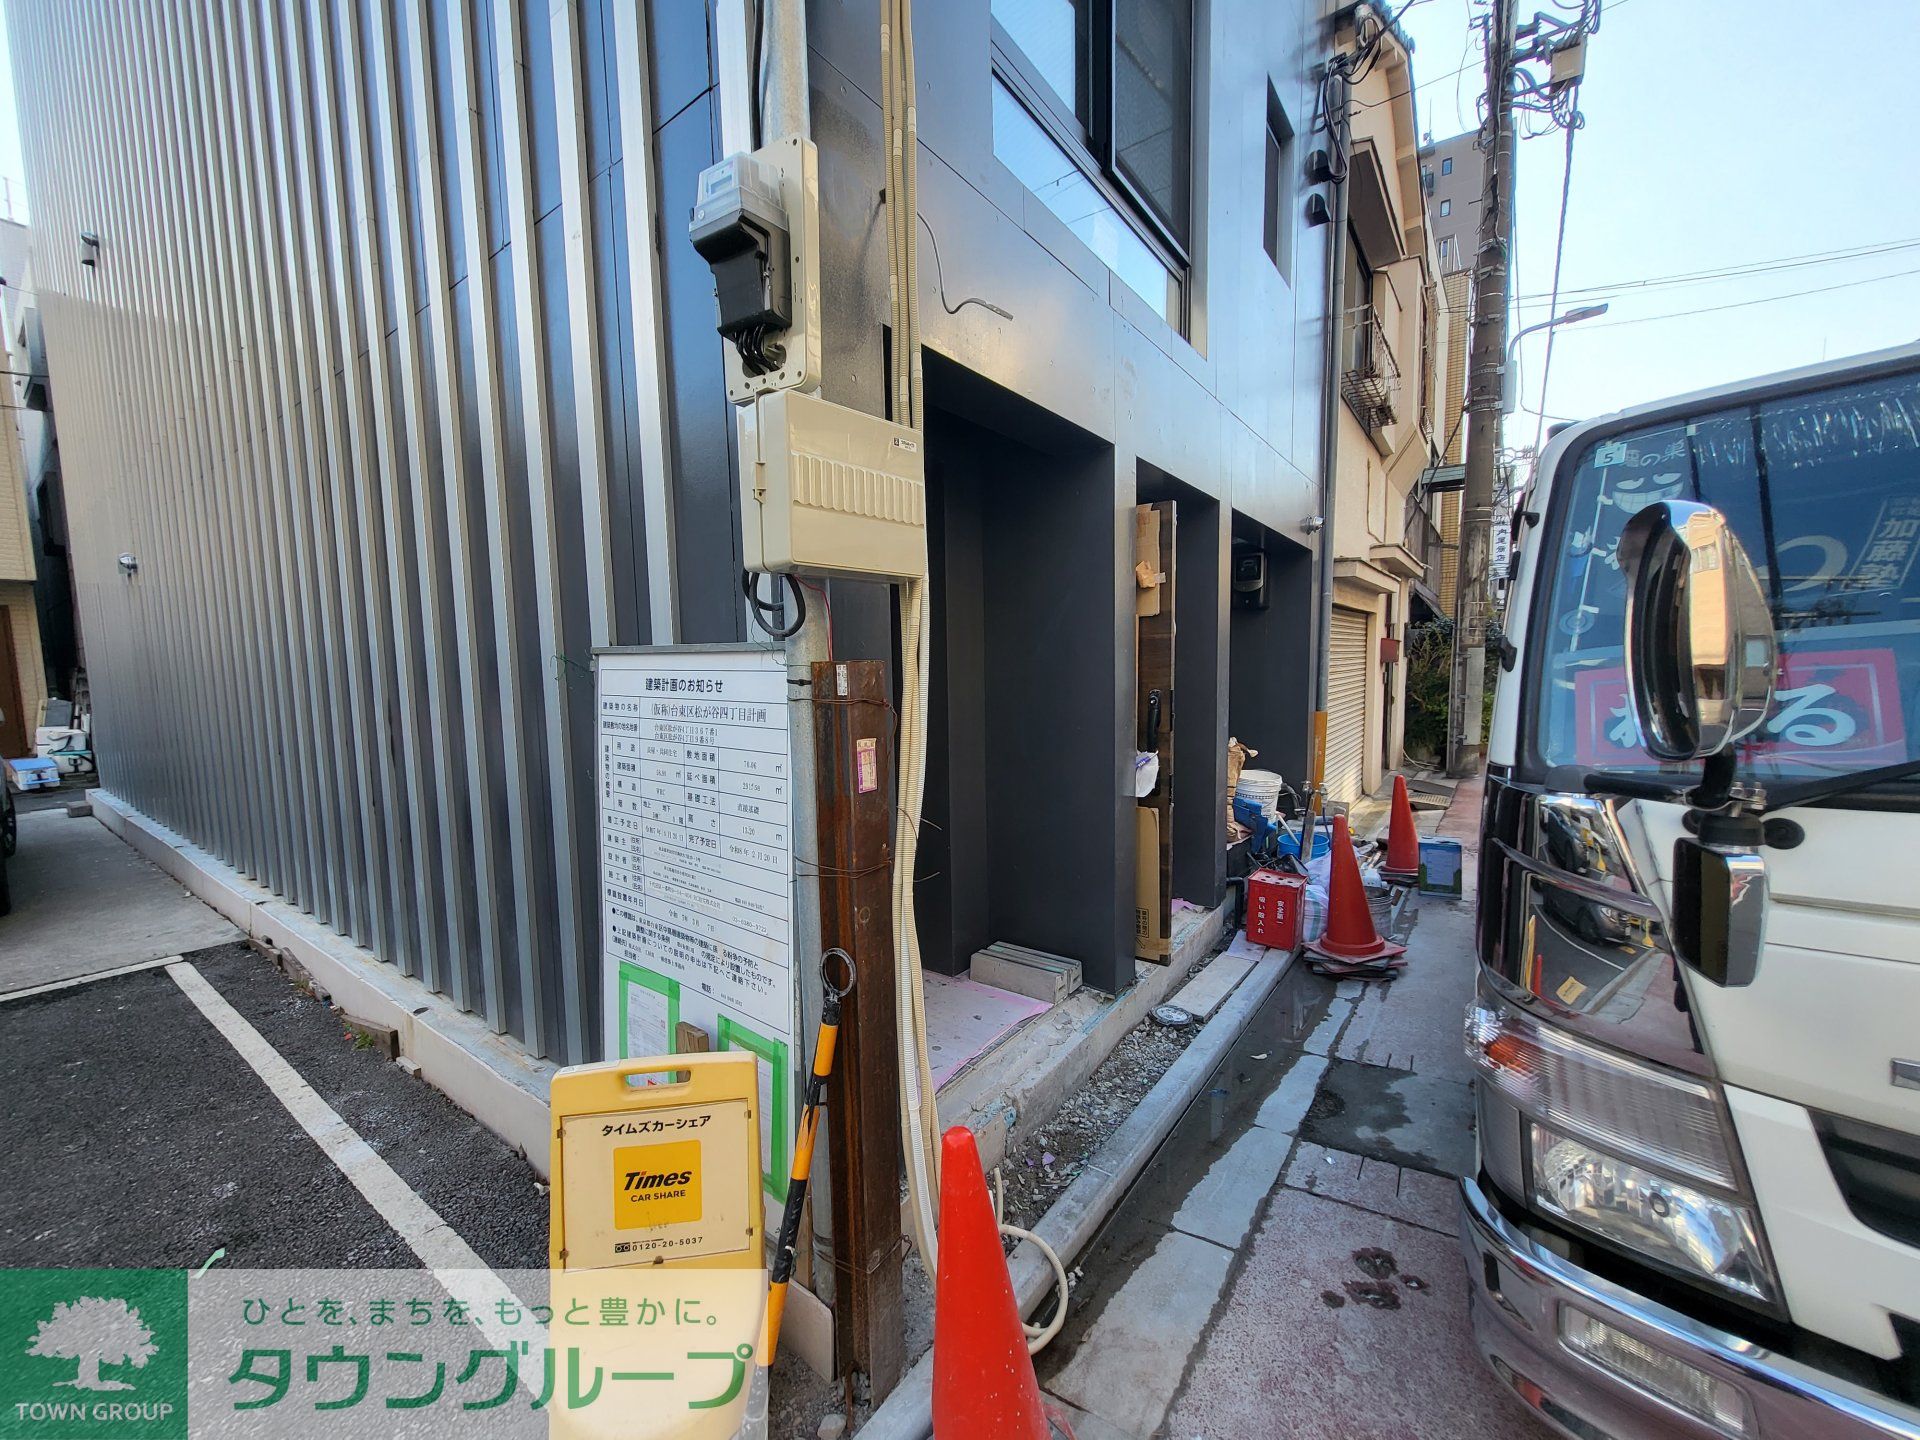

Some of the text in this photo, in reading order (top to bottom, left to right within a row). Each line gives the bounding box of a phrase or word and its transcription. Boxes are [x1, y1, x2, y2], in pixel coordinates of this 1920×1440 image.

[1604, 452, 1614, 464] 5
[645, 677, 724, 693] 建築計画のお知らせ
[602, 701, 639, 713] 建築物の名称
[651, 703, 768, 723] (仮称)台東区松が谷四丁目計画
[686, 748, 716, 763] 敷地面積
[686, 773, 716, 785] 延べ面積
[687, 793, 716, 806] 基礎工法
[607, 815, 638, 830] 着工予定日
[607, 834, 627, 846] 建築主
[688, 834, 717, 849] 完了予定日
[607, 888, 644, 908] 標識設置年月日
[601, 1115, 712, 1137] タイムズカーシェア
[623, 1170, 692, 1191] Times
[630, 1190, 686, 1203] CAR SHARE
[632, 1236, 704, 1251] 0120-20-5037
